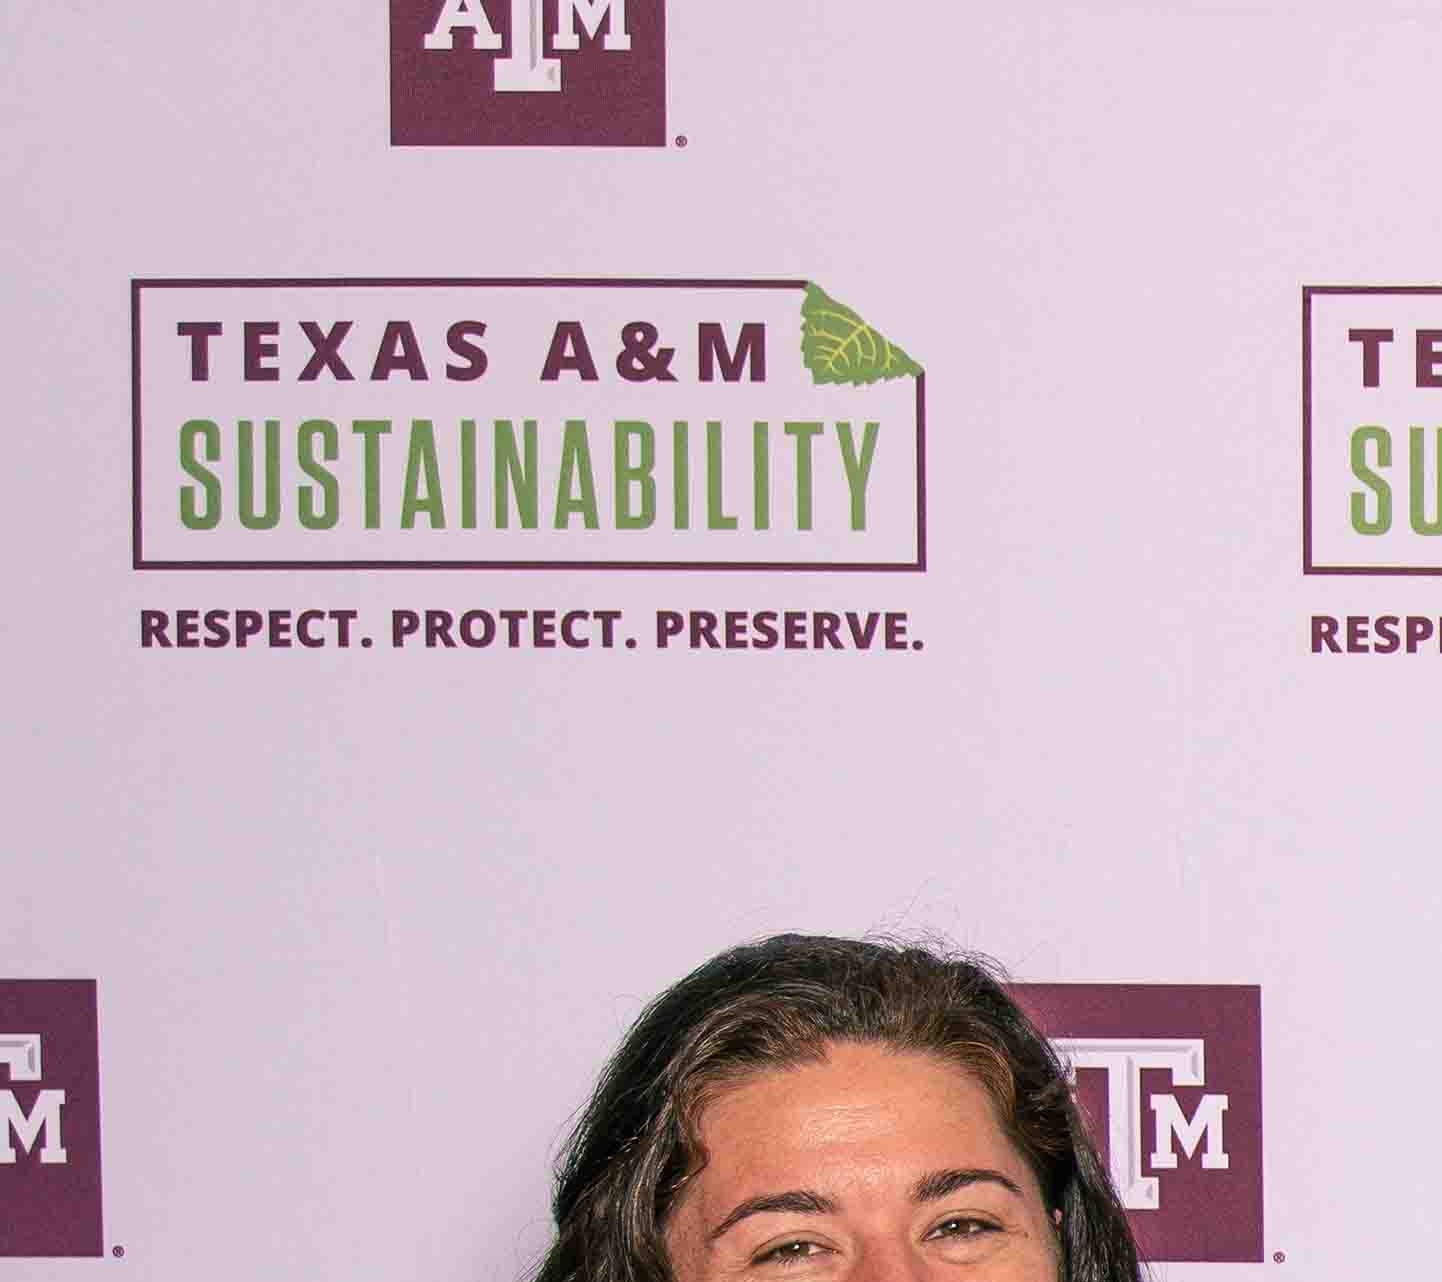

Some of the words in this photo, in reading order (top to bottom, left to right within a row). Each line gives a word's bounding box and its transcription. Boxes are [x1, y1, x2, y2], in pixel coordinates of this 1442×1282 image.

[177, 321, 487, 381] TEXAS
[540, 321, 765, 382] A&M
[180, 419, 880, 530] SUSTAINABILITY
[141, 610, 372, 648] RESPECT.
[392, 610, 636, 648] PROTECT.
[656, 611, 923, 650] PRESERVE.
